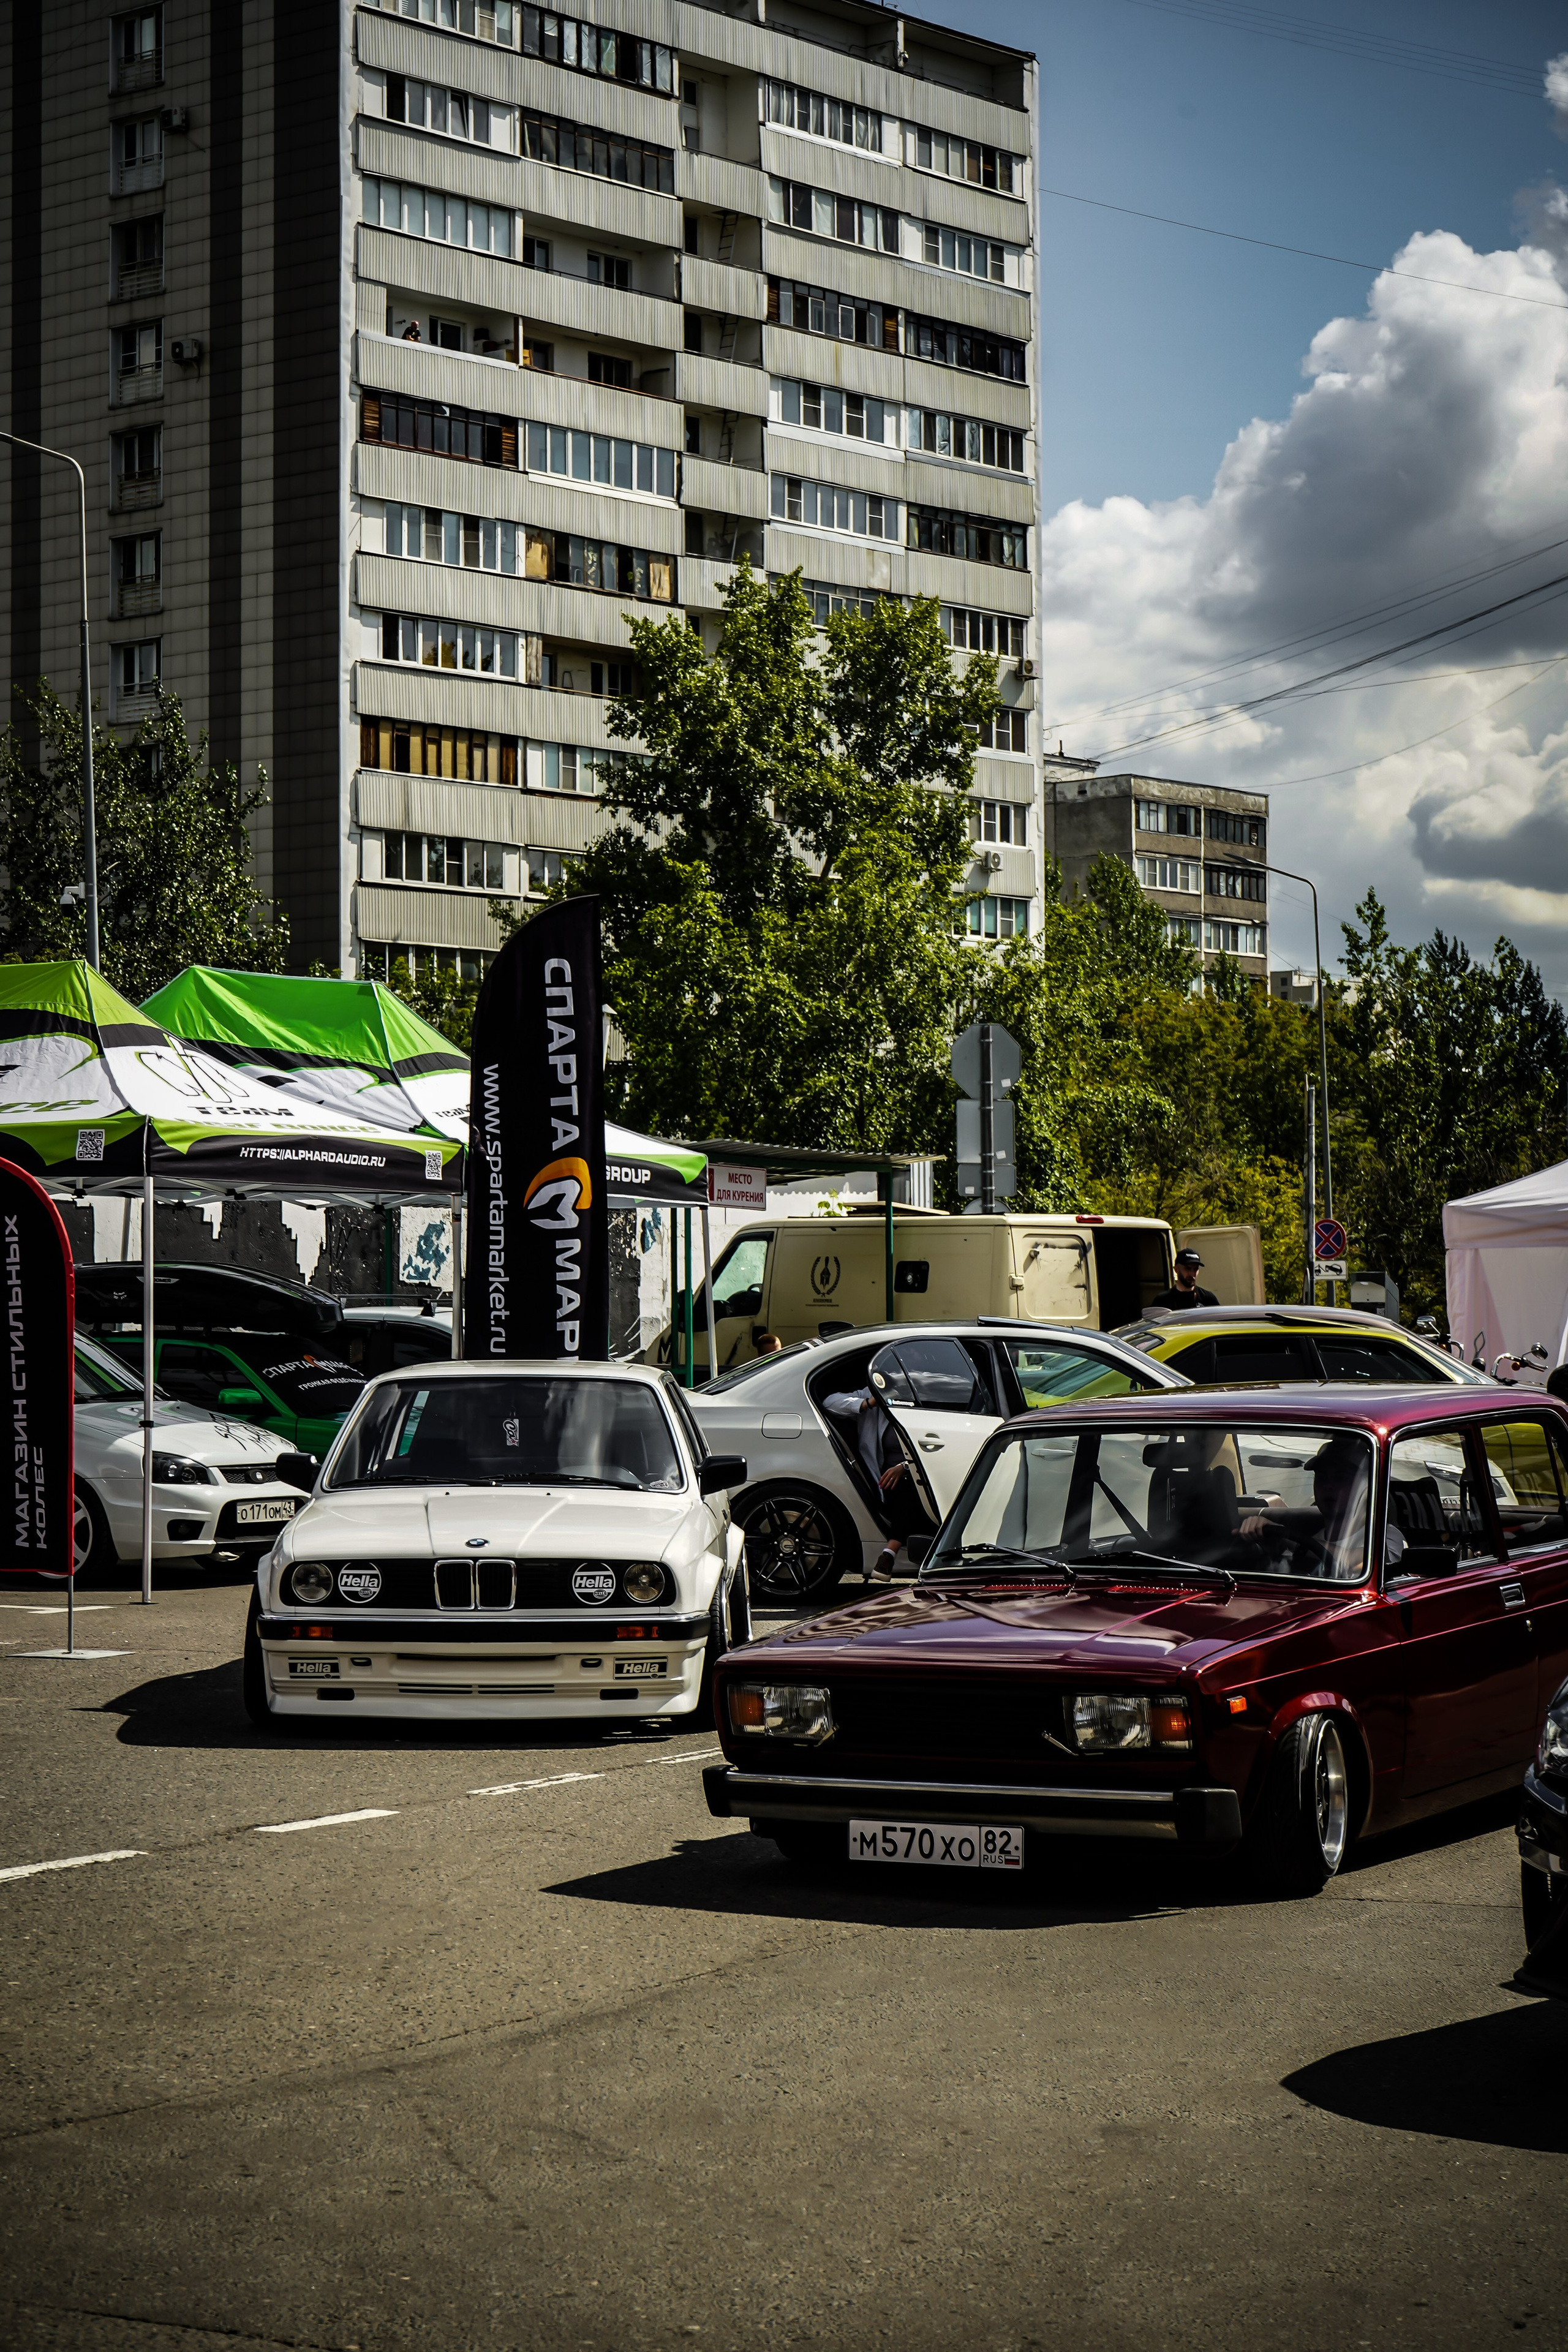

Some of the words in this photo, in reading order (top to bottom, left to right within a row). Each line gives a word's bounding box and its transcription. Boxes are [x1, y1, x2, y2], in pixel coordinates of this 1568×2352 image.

[545, 958, 579, 1152] СПАРТА
[239, 1147, 386, 1167] HTTPS://ALPHARDAUDIO.RU
[728, 1172, 752, 1185] МЕСТО
[717, 1189, 731, 1201] ДЛЯ
[733, 1189, 764, 1203] КУРЕНИЯ
[483, 1064, 510, 1354] www.spartamarket.ru
[4, 1215, 26, 1392] СТИЛЬНЫХ
[556, 1238, 581, 1360] МАР
[262, 1360, 314, 1378] СПАРТА
[298, 1379, 331, 1390] ГРОМКАЯ
[13, 1398, 30, 1548] МАГАЗИН
[33, 1446, 47, 1549] КОЛЕС
[241, 1504, 281, 1520] О171ОМ
[283, 1501, 292, 1514] 43
[341, 1575, 379, 1587] Hella
[575, 1576, 612, 1588] Hella
[296, 1663, 331, 1673] Hella
[623, 1662, 659, 1673] Hella
[859, 1825, 975, 1861] М570ХО
[984, 1830, 1012, 1855] 82
[983, 1855, 1003, 1864] RUS
